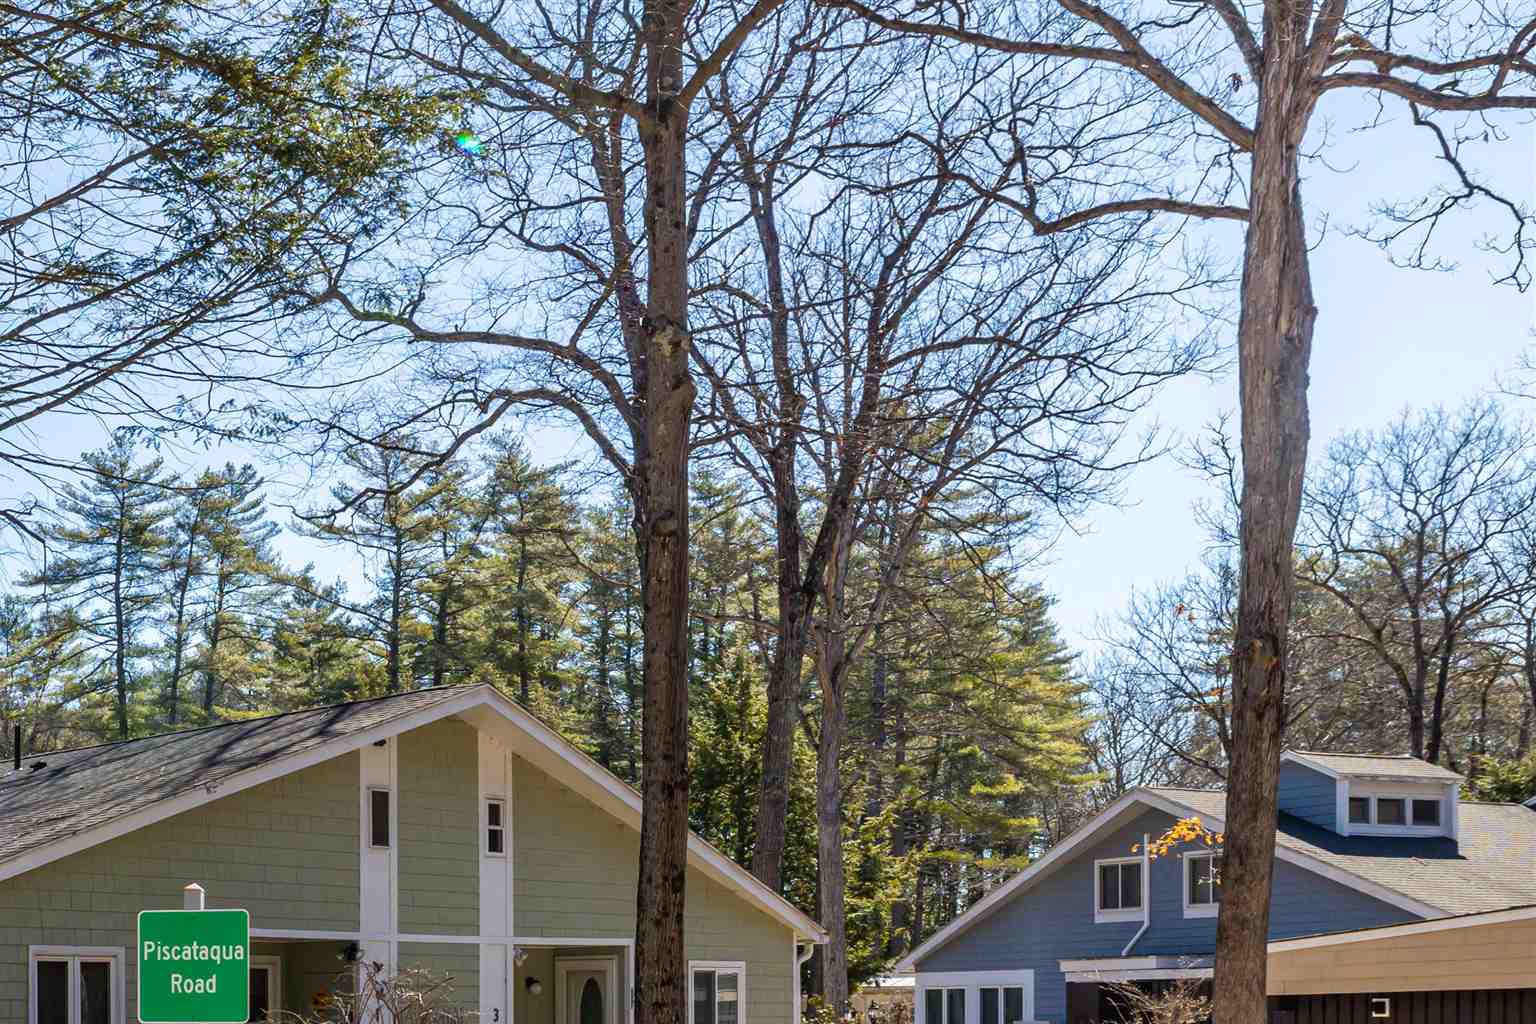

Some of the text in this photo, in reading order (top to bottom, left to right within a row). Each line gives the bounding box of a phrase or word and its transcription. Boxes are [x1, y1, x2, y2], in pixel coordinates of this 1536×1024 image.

[143, 941, 244, 964] Piscataqua
[170, 973, 217, 994] Road
[492, 1008, 500, 1023] 3
